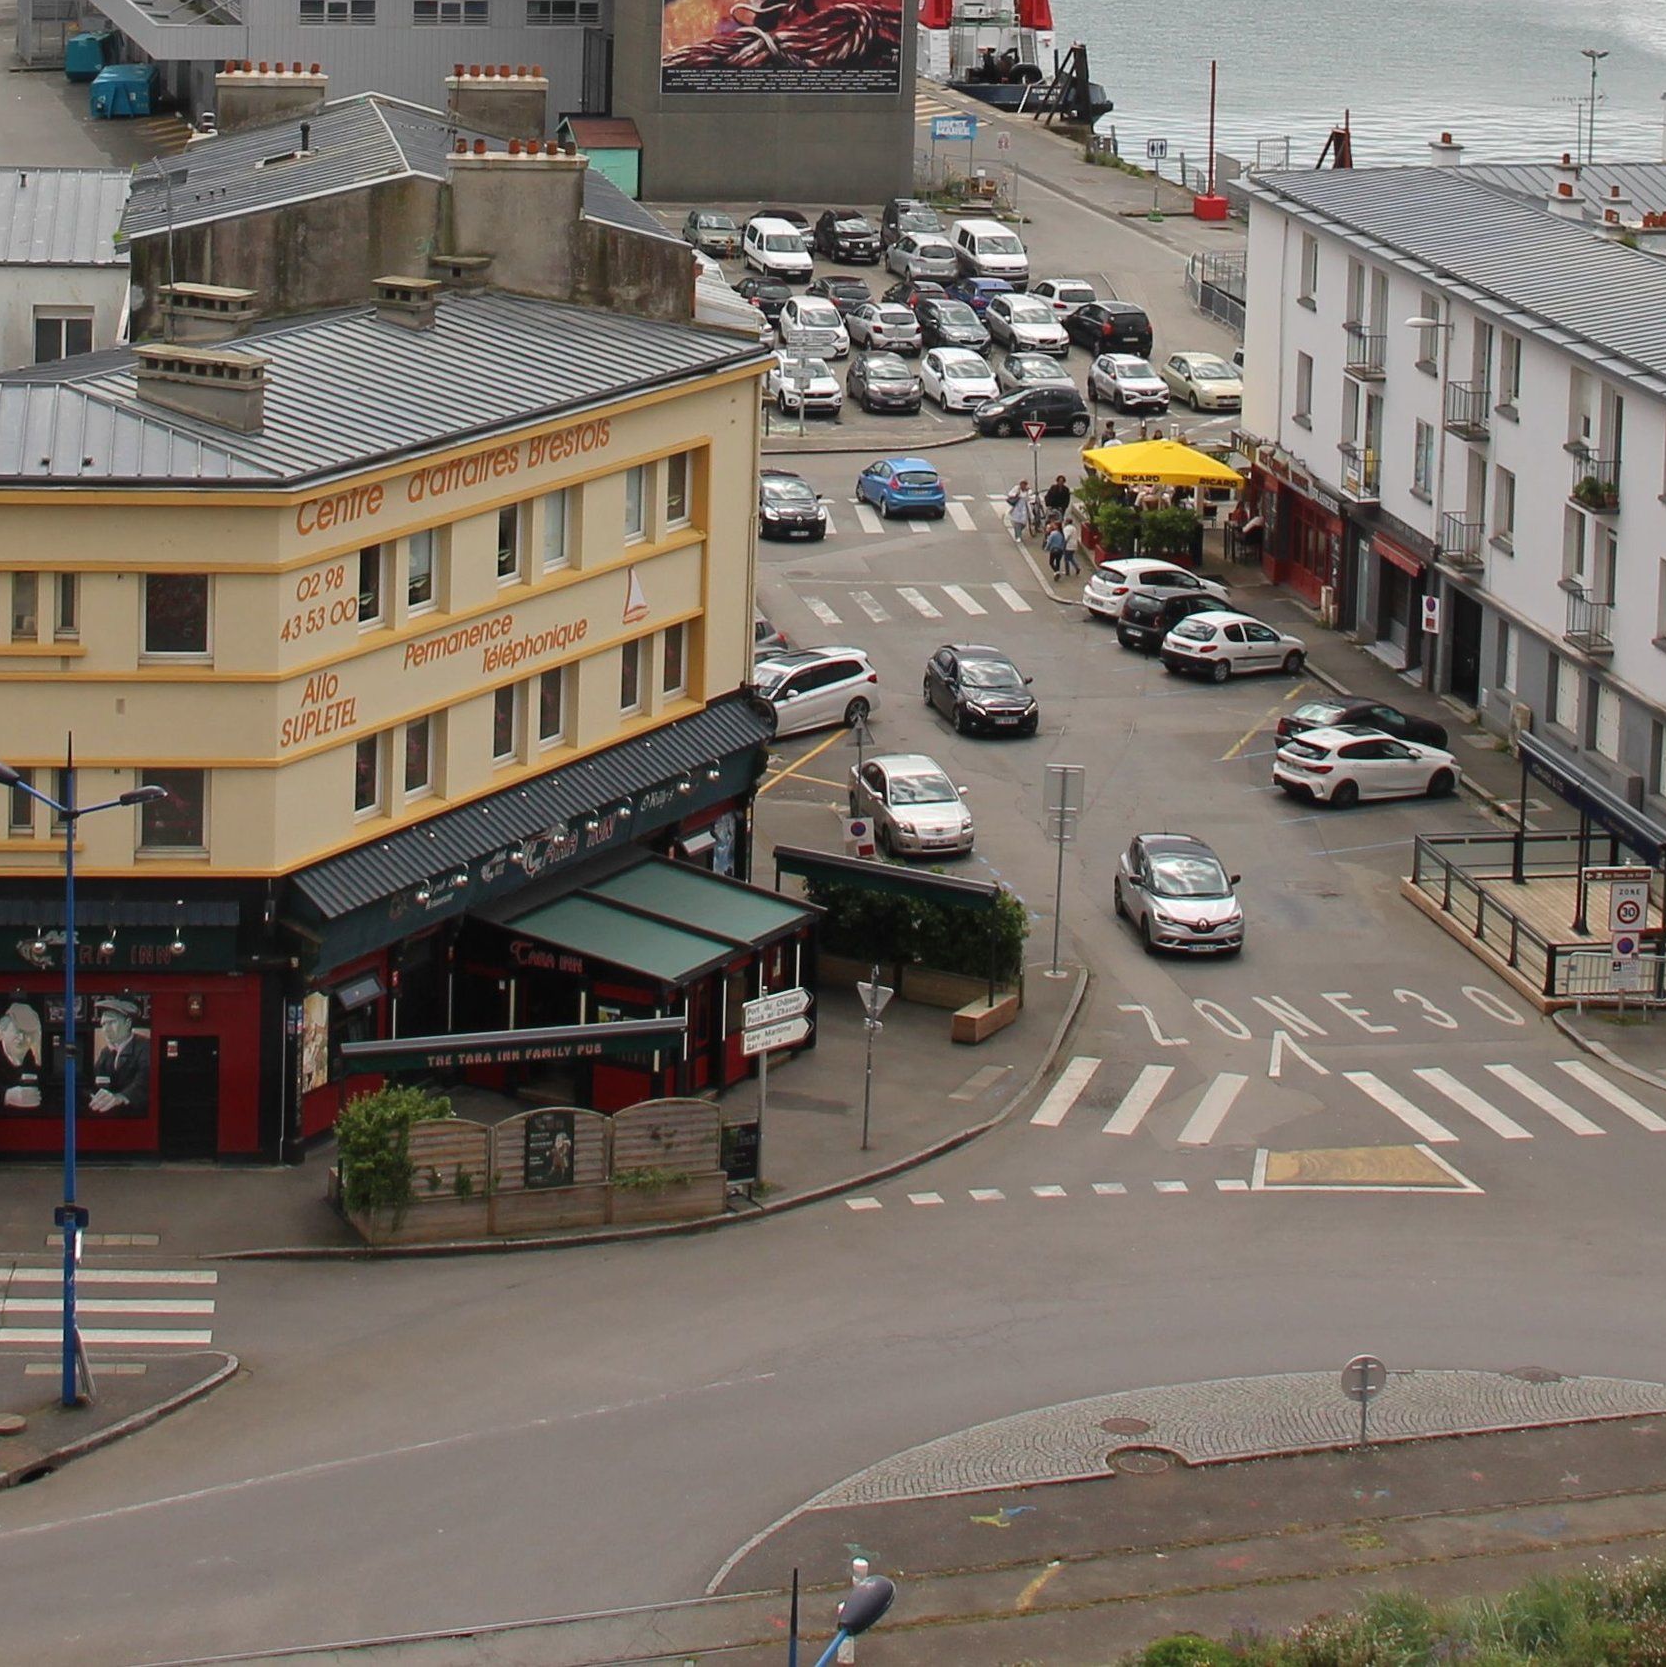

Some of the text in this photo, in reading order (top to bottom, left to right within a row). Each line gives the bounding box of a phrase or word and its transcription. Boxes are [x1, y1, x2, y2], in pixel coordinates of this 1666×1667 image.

[296, 418, 611, 536] Centre d'affaires Brestois
[1121, 473, 1161, 483] RICARD
[1199, 477, 1239, 488] RICARD
[296, 564, 345, 602] 02 98
[281, 596, 358, 643] 43 53 00
[403, 613, 514, 671] Permanence
[481, 618, 589, 675] Téléphonique
[301, 672, 339, 709] Allo
[280, 697, 358, 749] SUPLETEL
[1621, 907, 1636, 917] 30
[129, 944, 174, 966] INN
[1117, 985, 1526, 1046] ZONE 30
[428, 1043, 603, 1068] THE TARA INN FAMILY PUB
